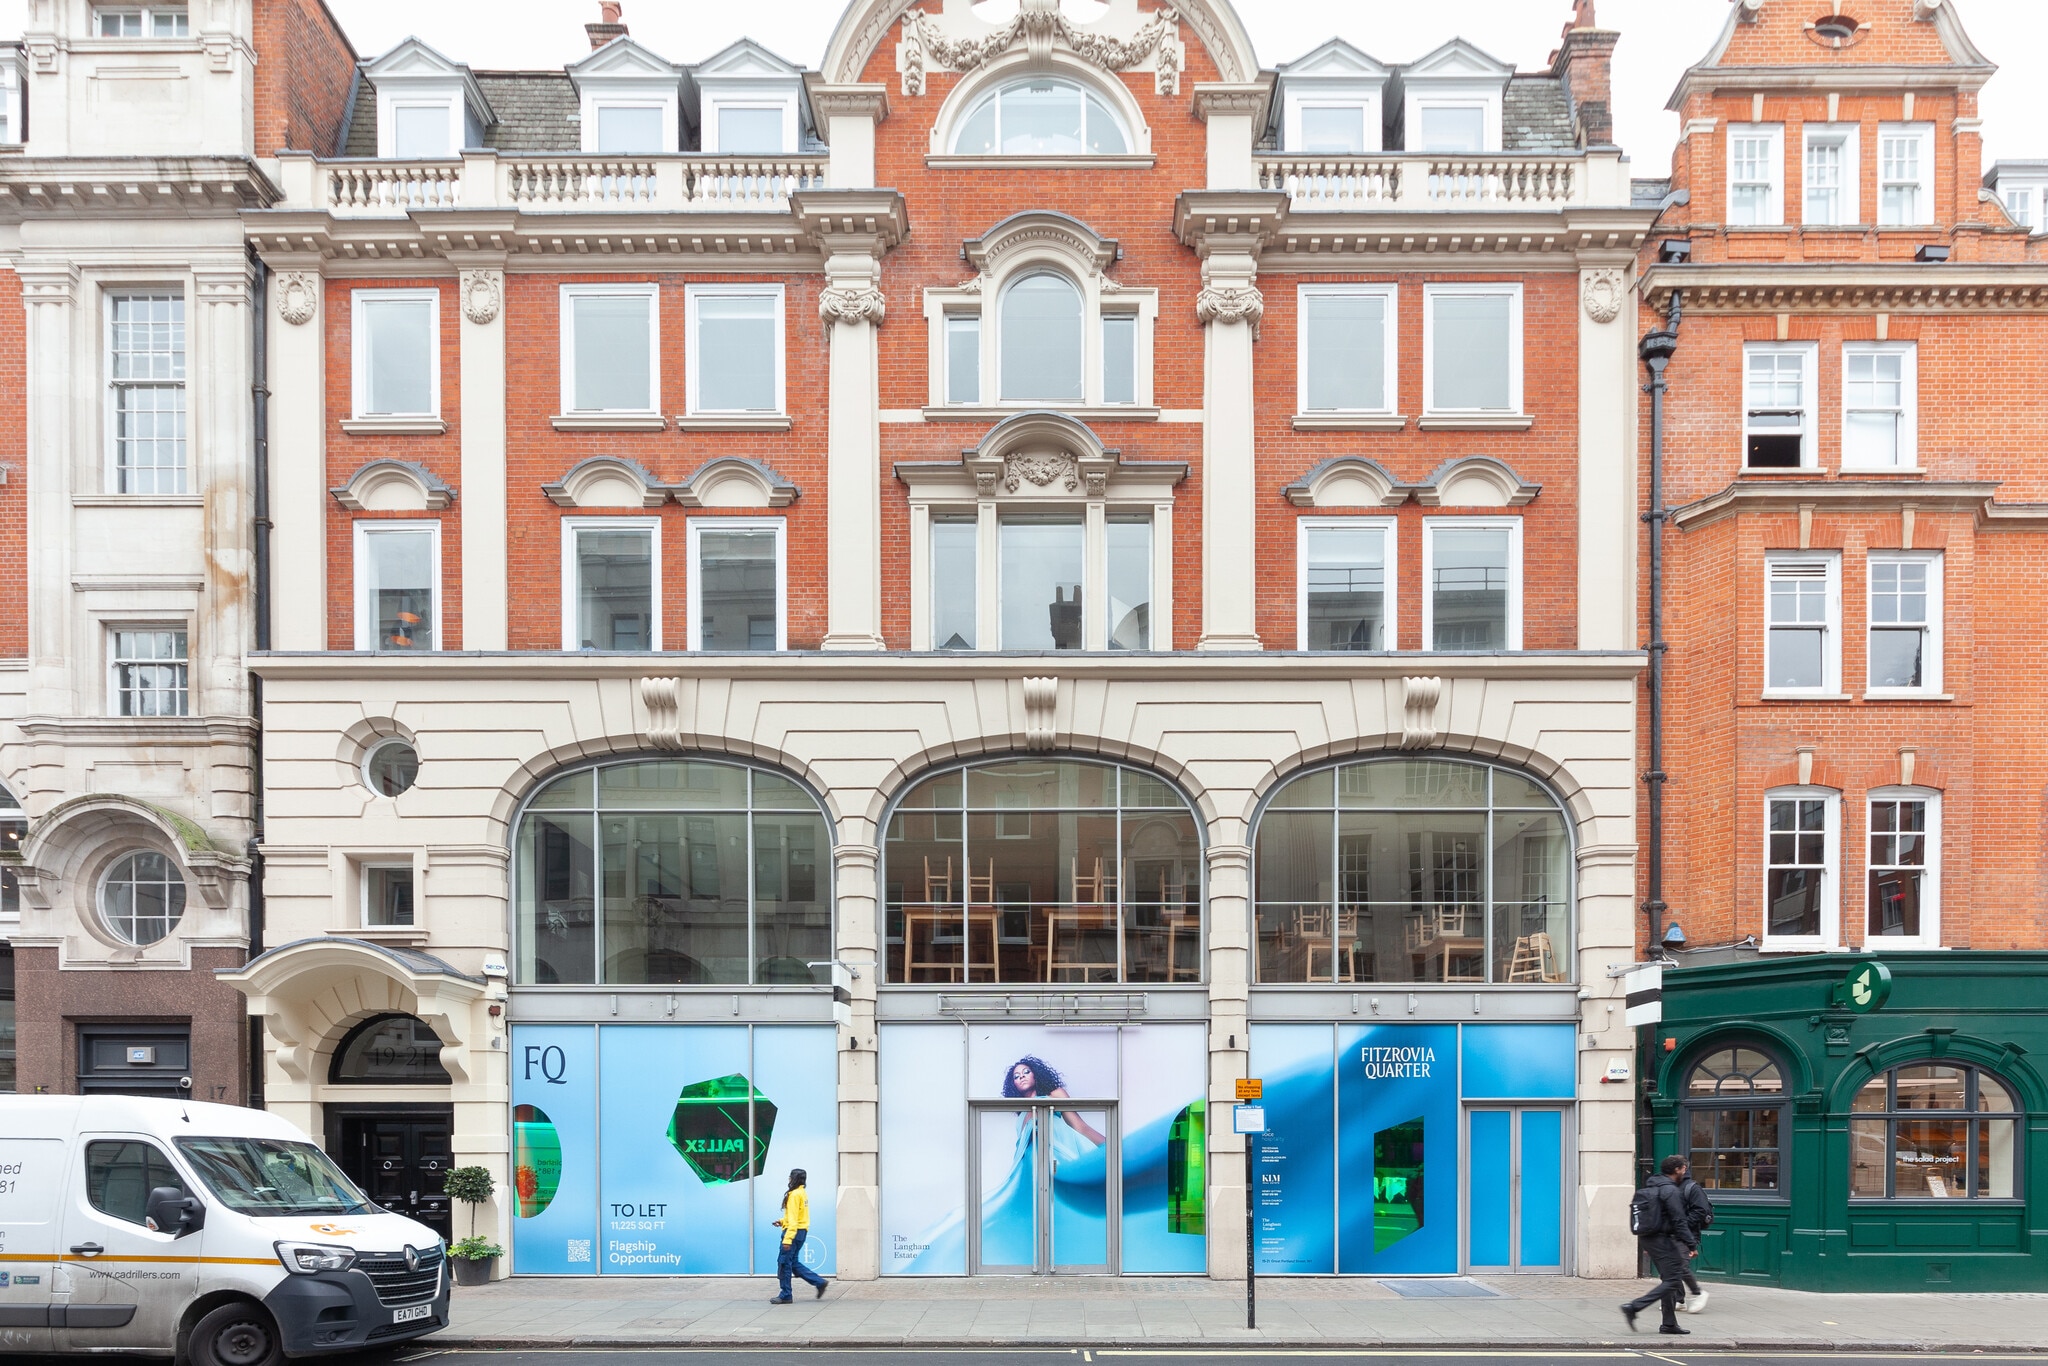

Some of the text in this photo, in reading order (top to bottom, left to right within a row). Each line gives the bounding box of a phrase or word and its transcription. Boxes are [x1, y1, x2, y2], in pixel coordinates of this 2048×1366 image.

[372, 1047, 428, 1067] 19-21
[1361, 1047, 1436, 1062] FITZROVIA
[524, 1045, 568, 1085] FQ
[1365, 1063, 1431, 1080] QUARTER
[209, 1086, 227, 1100] 17
[1935, 1156, 1959, 1164] project
[610, 1204, 668, 1217] TO LET
[610, 1221, 666, 1231] 11,225 SQ FT
[891, 1234, 908, 1242] The
[610, 1240, 657, 1253] Flagship
[894, 1243, 930, 1252] Langham
[609, 1253, 682, 1266] Opportunity
[89, 1269, 181, 1280] www.cadrillers.com
[397, 1309, 414, 1321] EA71
